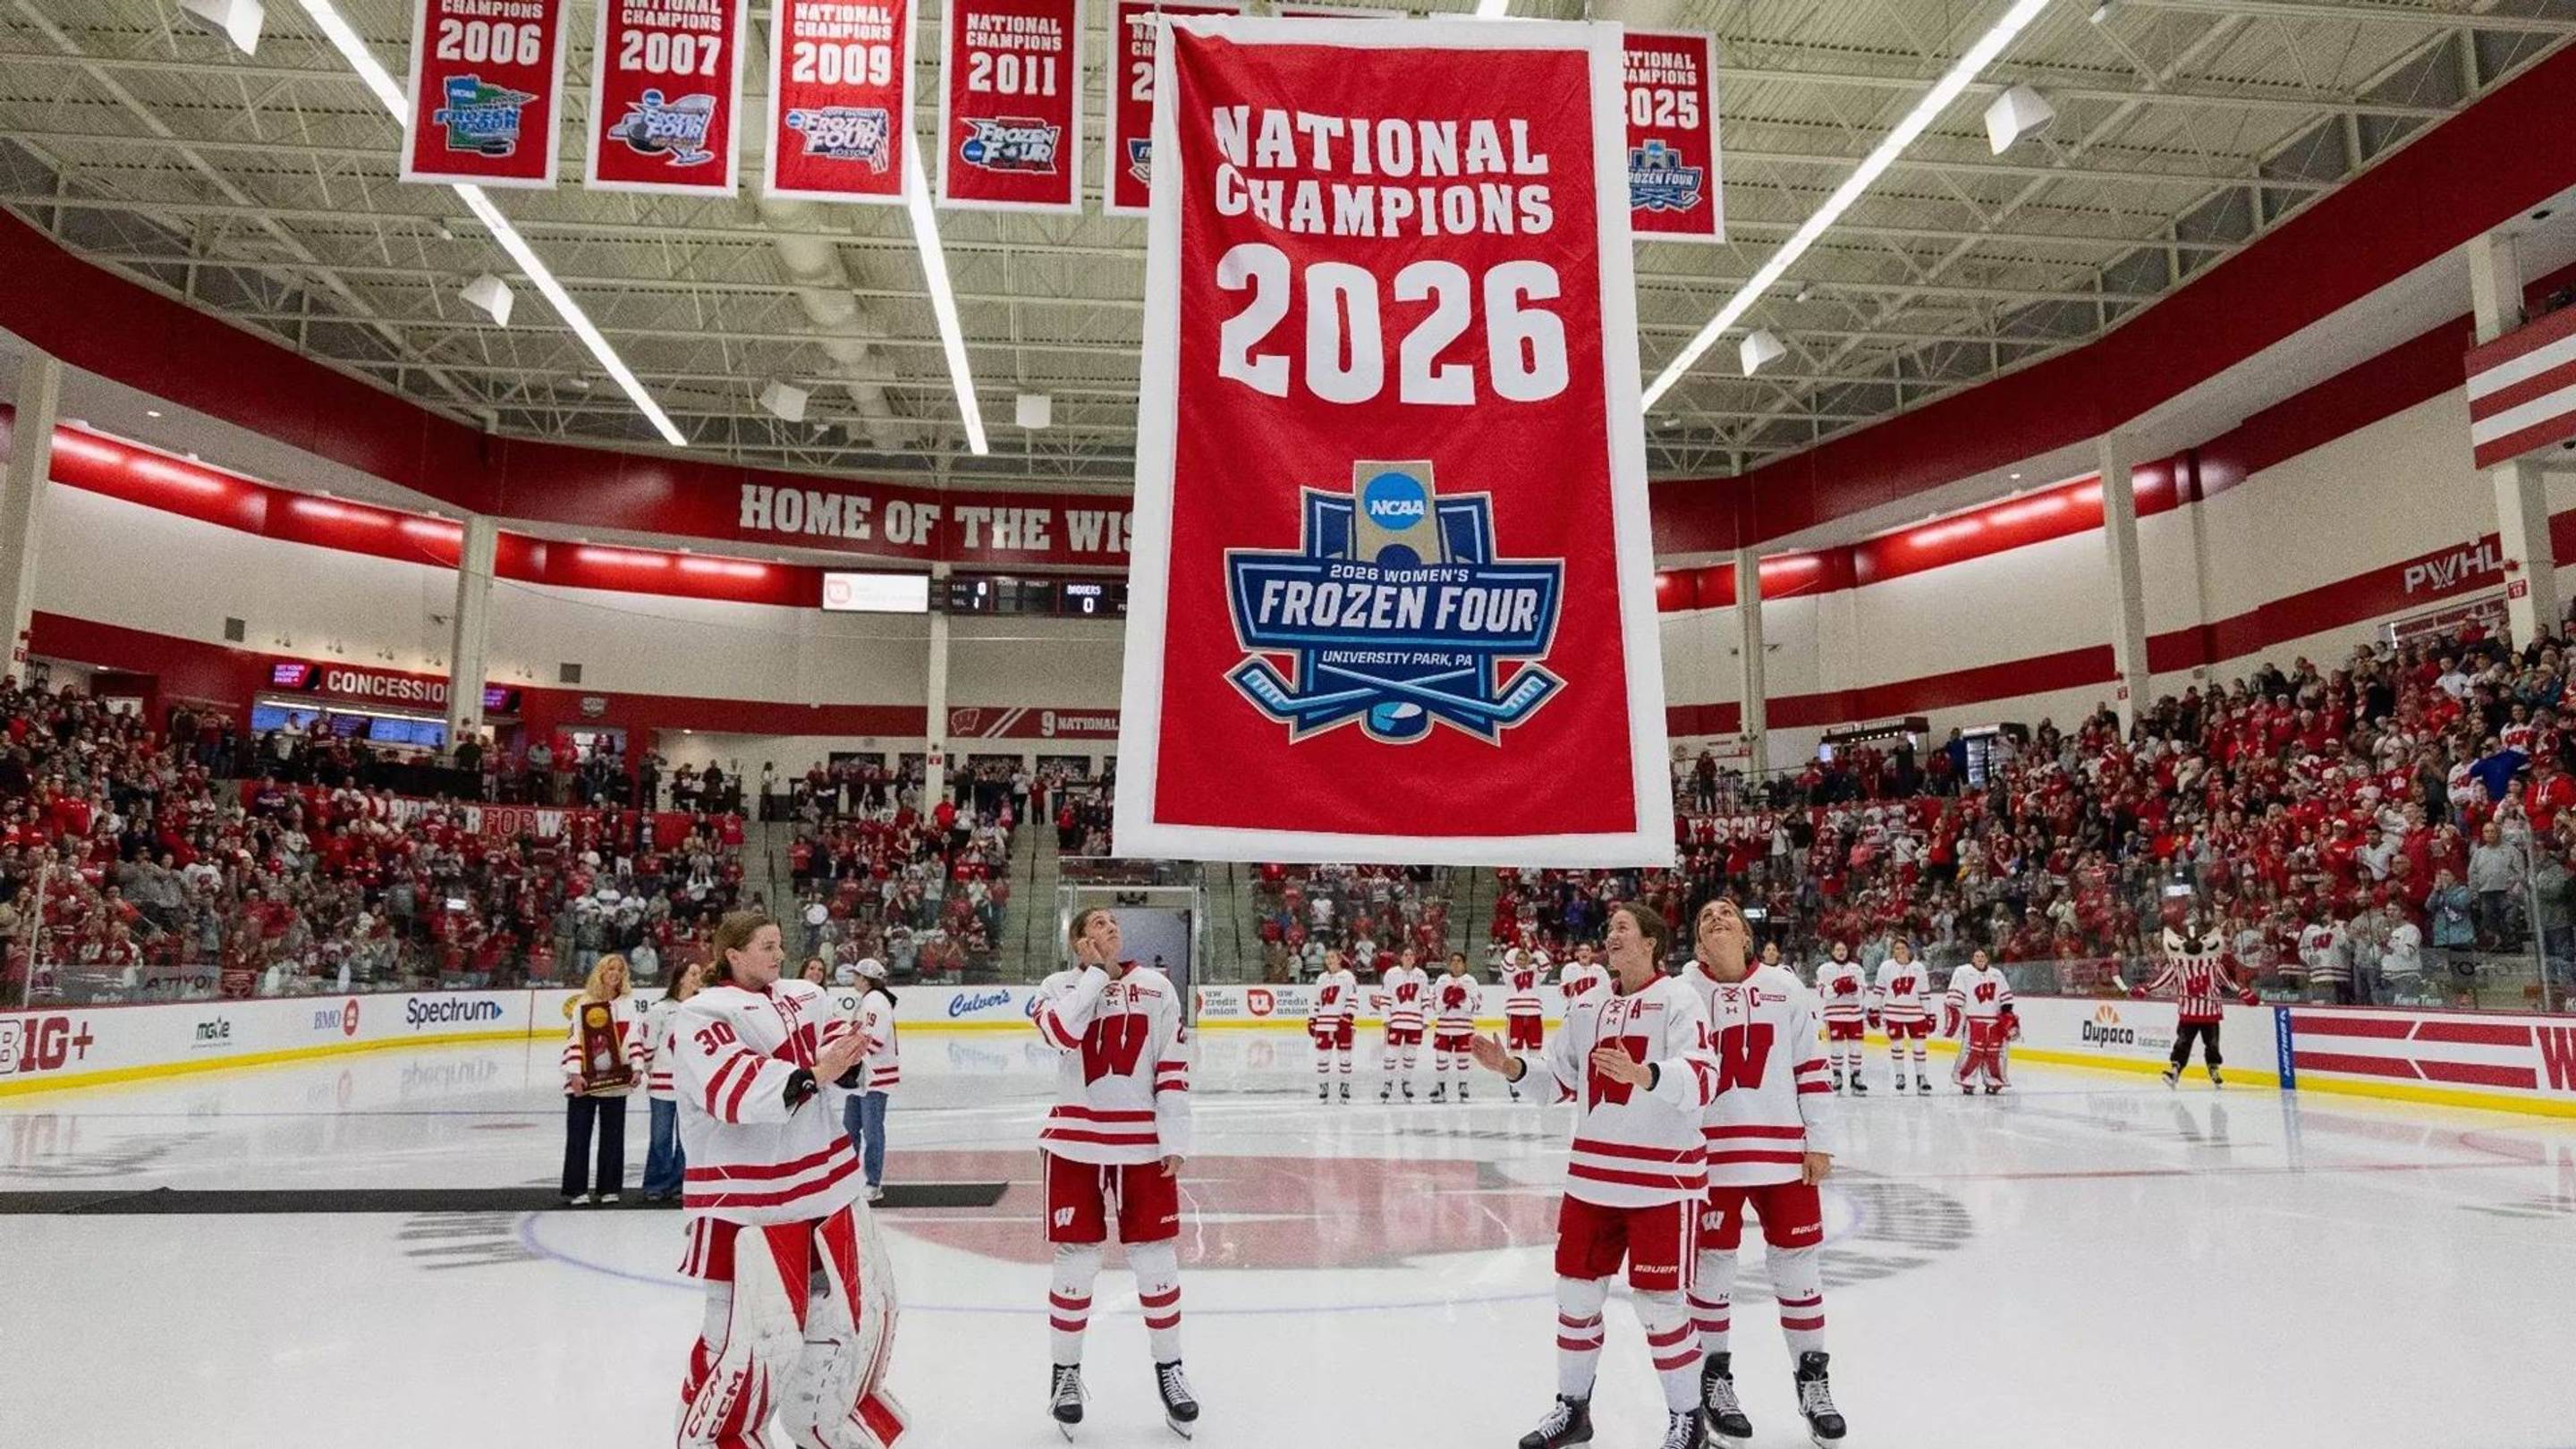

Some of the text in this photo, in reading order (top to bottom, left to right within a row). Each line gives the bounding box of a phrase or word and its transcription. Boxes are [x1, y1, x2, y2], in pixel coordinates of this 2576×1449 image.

[441, 0, 544, 19] CHAMPIONS
[794, 3, 893, 24] NATIONAL
[622, 10, 722, 31] CHAMPIONS
[793, 21, 893, 41] CHAMPIONS
[967, 13, 1063, 35] NATIONAL
[436, 19, 542, 65] 2006
[966, 30, 1063, 51] CHAMPIONS
[620, 30, 722, 76] 2007
[792, 41, 892, 86] 2009
[1623, 51, 1697, 70] ATIONAL
[969, 51, 1056, 96] 2011
[1624, 68, 1698, 85] AMPIONS
[1624, 88, 1699, 129] 025
[805, 113, 880, 134] FROZEN
[977, 122, 1057, 145] FROZEN
[806, 131, 877, 152] FOUR
[1212, 106, 1548, 176] NATIONAL
[1665, 173, 1694, 186] FOUR
[1215, 163, 1554, 237] CHAMPIONS
[1216, 243, 1569, 405] 2026
[740, 484, 873, 539] HOME
[885, 500, 940, 546] OF
[954, 505, 1051, 551] THE
[1370, 500, 1425, 515] NCAA
[1330, 564, 1470, 583] 2026 WOMEN'S
[2403, 544, 2505, 594] PWHL
[1083, 597, 1094, 614] 0
[1258, 580, 1538, 632] FROZEN FOUR
[1322, 650, 1473, 667] UNIVERSITY PARK, PA
[1041, 710, 1119, 737] 9 NATIONAL
[948, 989, 1011, 1018] Culver's
[1129, 984, 1140, 1003] A
[1205, 997, 1238, 1006] credit
[1276, 997, 1309, 1006] credit
[1750, 987, 1760, 1007] C
[313, 1009, 341, 1030] BMO
[406, 996, 496, 1030] Spectrum
[1205, 1007, 1238, 1015] union
[1276, 1007, 1309, 1015] union
[1630, 998, 1642, 1020] A
[694, 1022, 736, 1056] 30
[2082, 1020, 2134, 1048] Dupaco
[1079, 1013, 1149, 1088] W
[1707, 1022, 1775, 1105] W
[1634, 1264, 1678, 1275] BAUER
[708, 1370, 745, 1438] CCM
